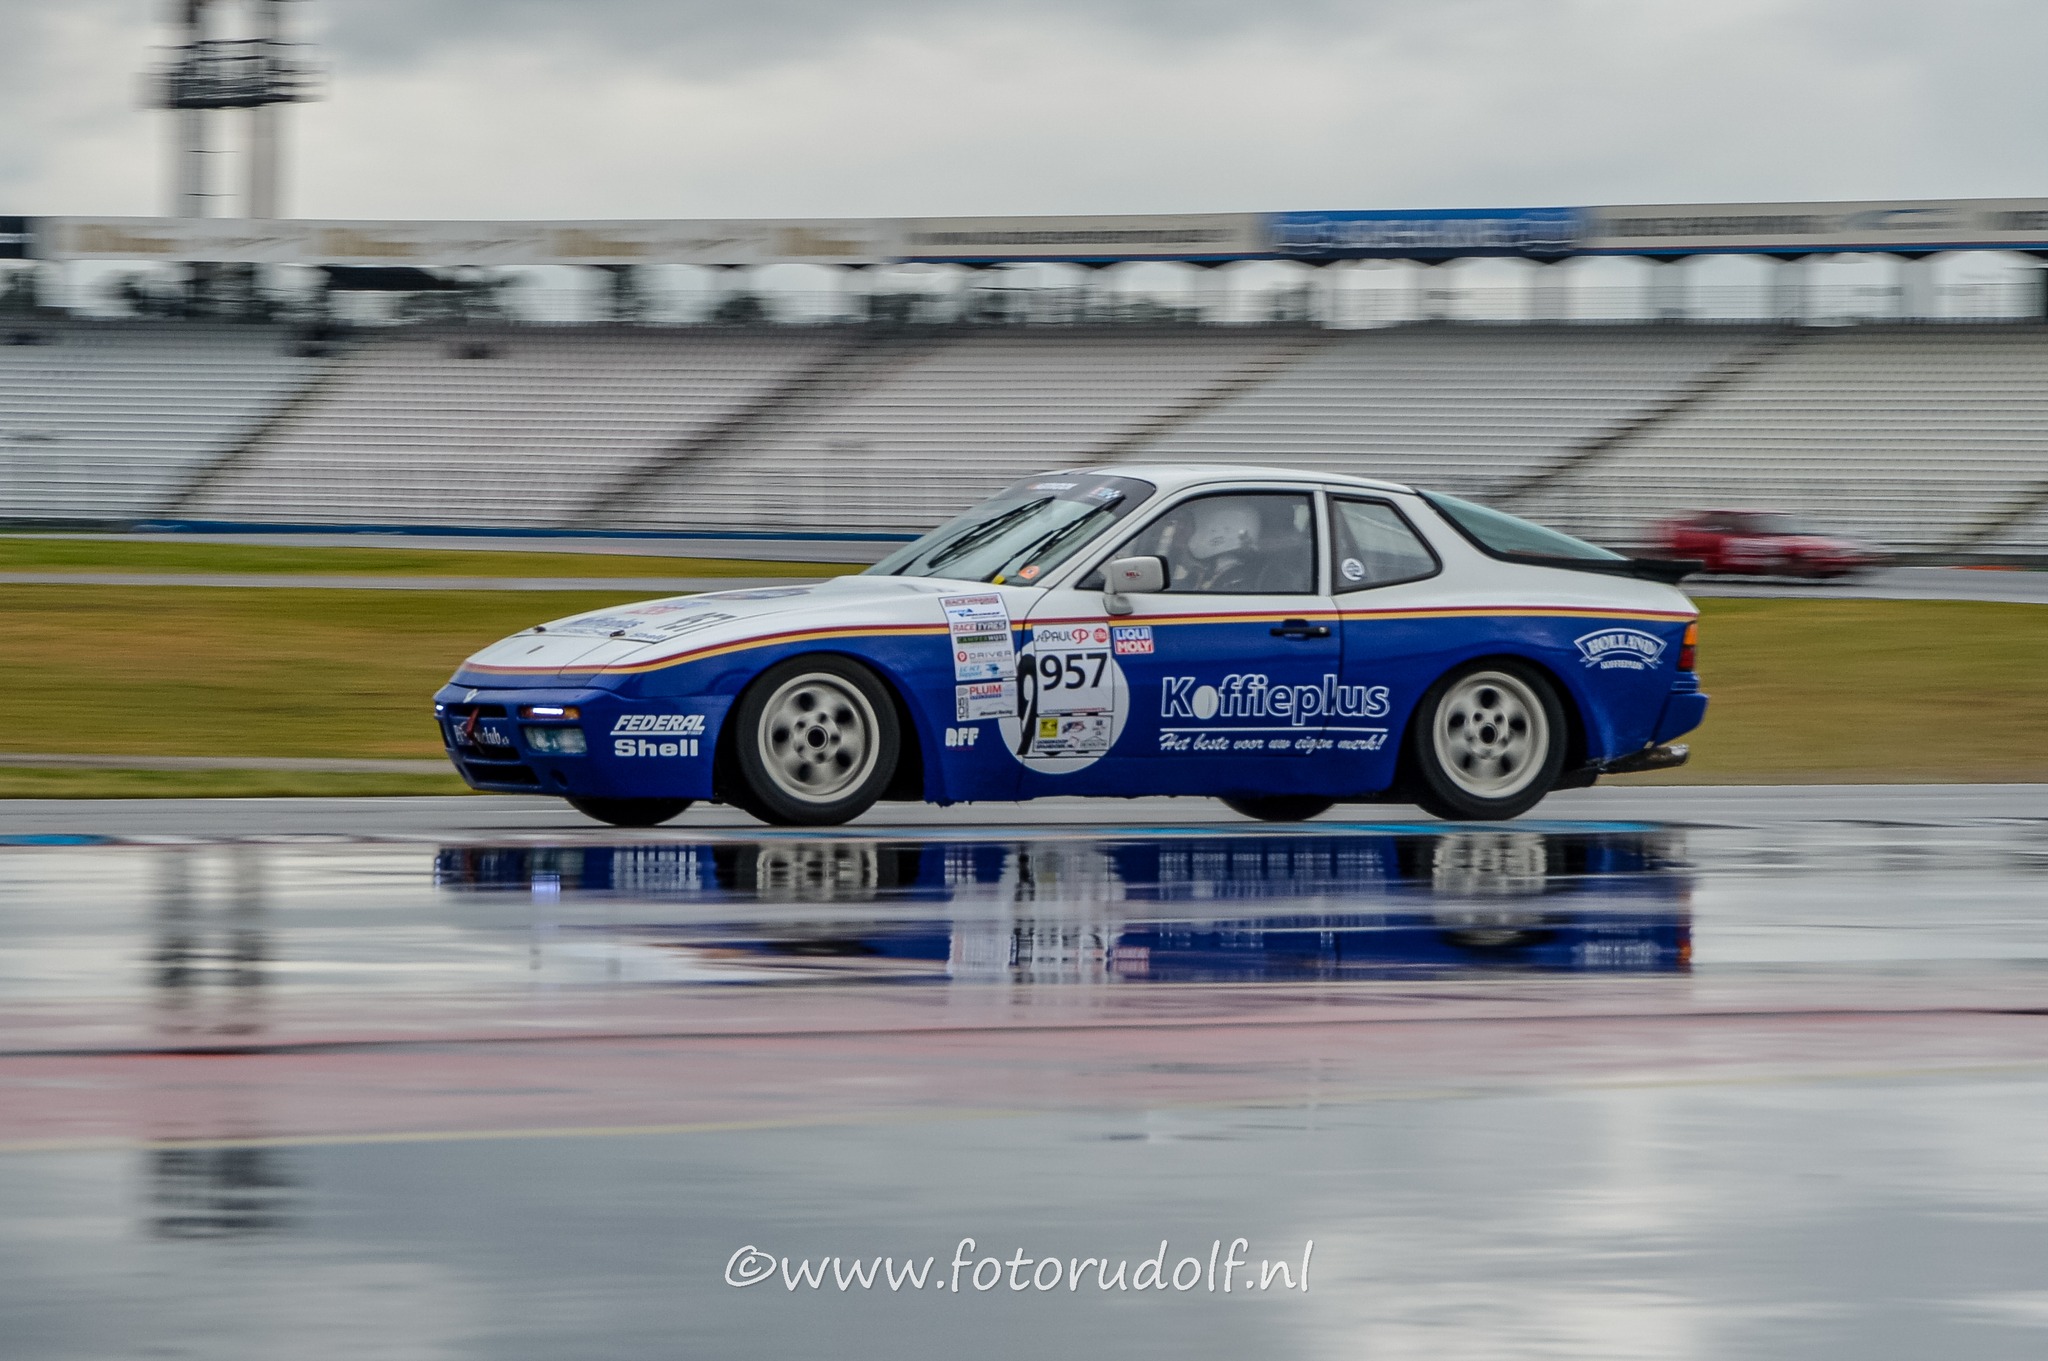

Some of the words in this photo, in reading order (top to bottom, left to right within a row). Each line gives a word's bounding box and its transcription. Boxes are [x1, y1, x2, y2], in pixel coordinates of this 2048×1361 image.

[1116, 628, 1150, 640] LIQUI
[1116, 640, 1153, 653] MOLY
[1586, 634, 1658, 655] HOLLAND
[968, 650, 1012, 660] DRIVER
[1040, 653, 1108, 691] 957
[969, 684, 1002, 695] PLUIM
[1160, 673, 1390, 726] Koffieplus
[613, 714, 706, 731] FEDERAL
[614, 738, 699, 757] Shell
[1158, 733, 1192, 750] Het
[1193, 733, 1230, 750] beste
[1233, 739, 1264, 750] voor
[1268, 739, 1291, 749] uw
[1295, 736, 1334, 755] eigen
[1337, 734, 1388, 750] merk!
